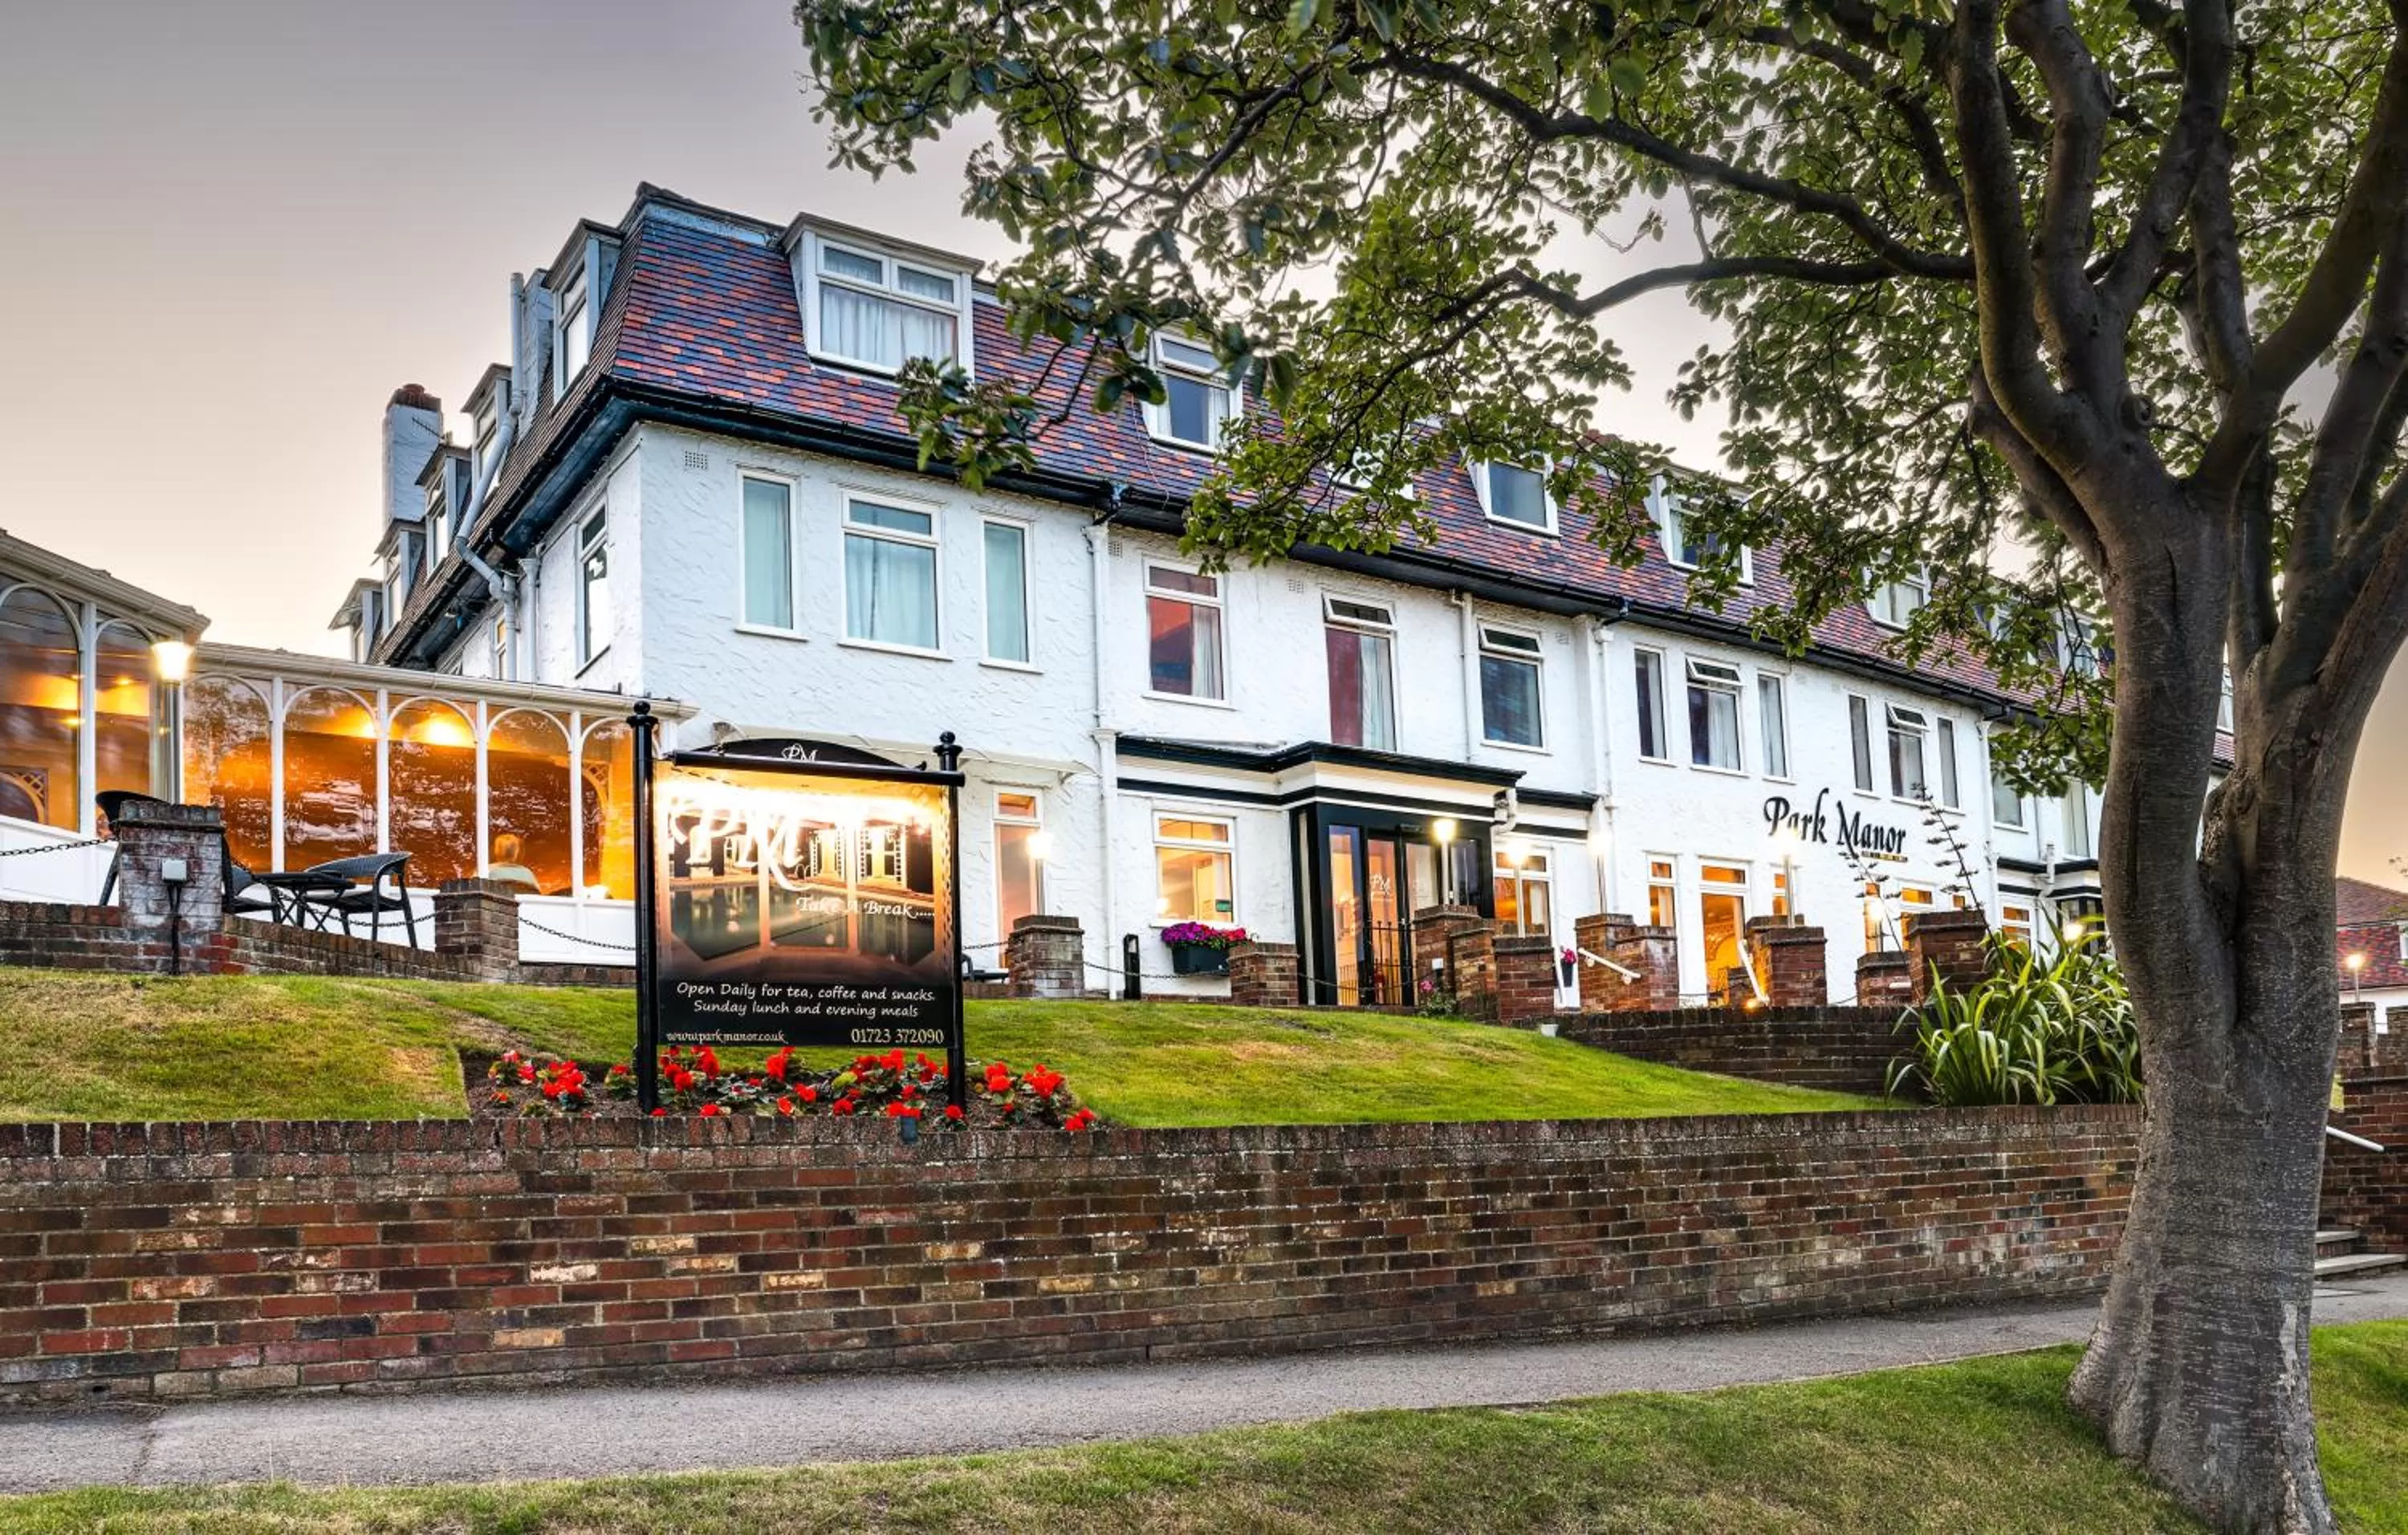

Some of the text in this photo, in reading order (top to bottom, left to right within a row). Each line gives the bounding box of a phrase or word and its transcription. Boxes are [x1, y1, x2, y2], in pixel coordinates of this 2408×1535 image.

[782, 743, 818, 761] PM
[1763, 788, 1906, 859] Park Manor
[677, 982, 936, 1001] Open Daily for tea, coffee and snacks.
[694, 1000, 919, 1020] Sunday lunch and evening meals
[851, 1028, 945, 1044] 01723 372090
